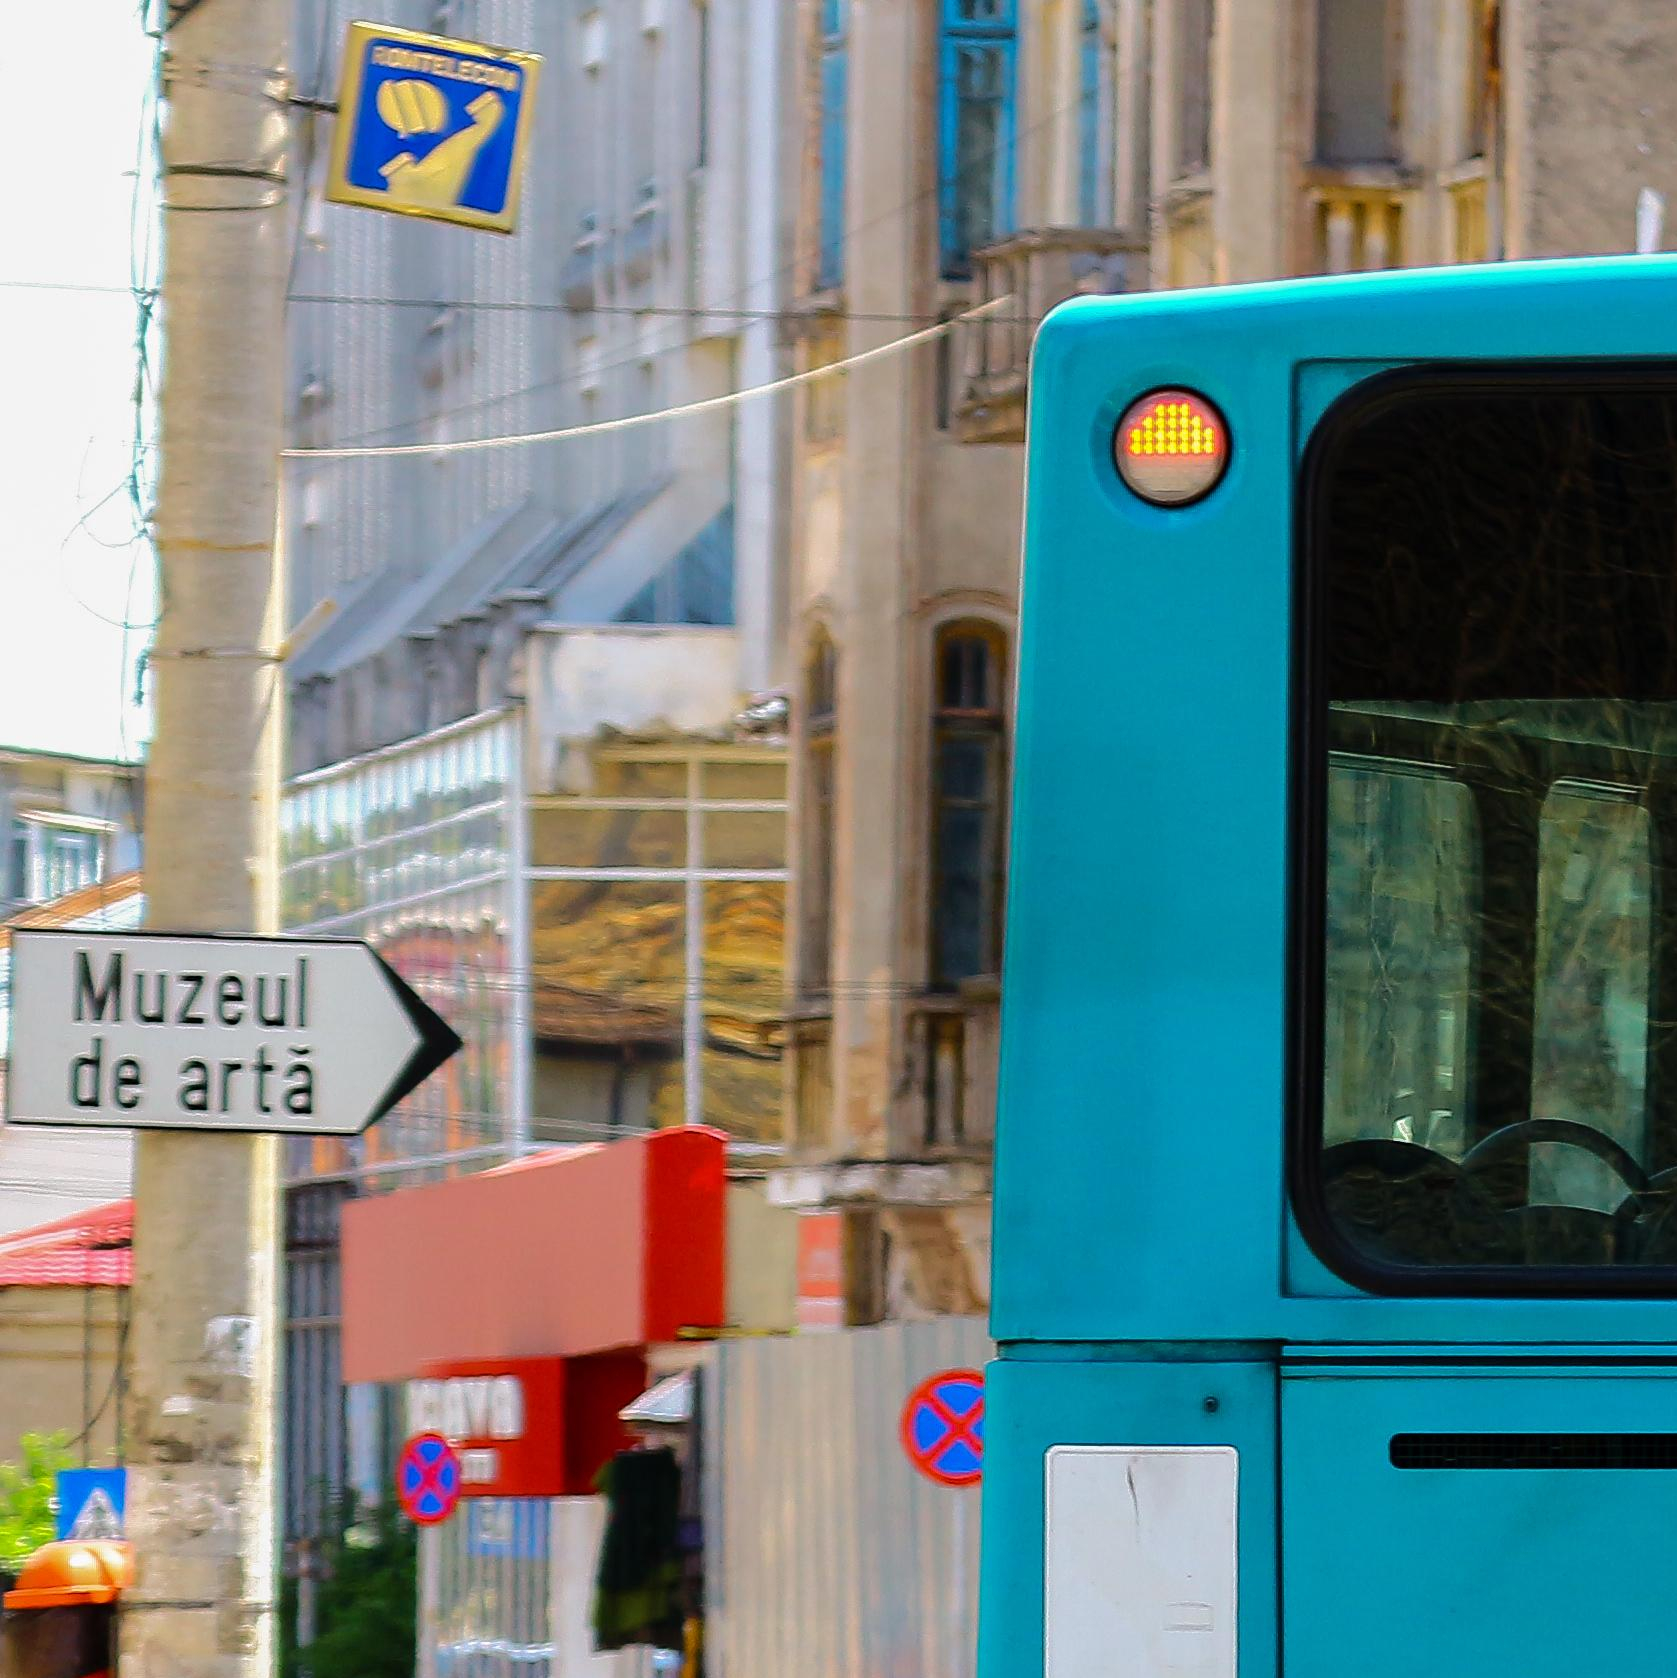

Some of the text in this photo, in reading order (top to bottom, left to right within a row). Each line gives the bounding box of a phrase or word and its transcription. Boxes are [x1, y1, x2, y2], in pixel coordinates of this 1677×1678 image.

[71, 950, 312, 1028] Muzeul
[69, 1035, 314, 1115] de artă
